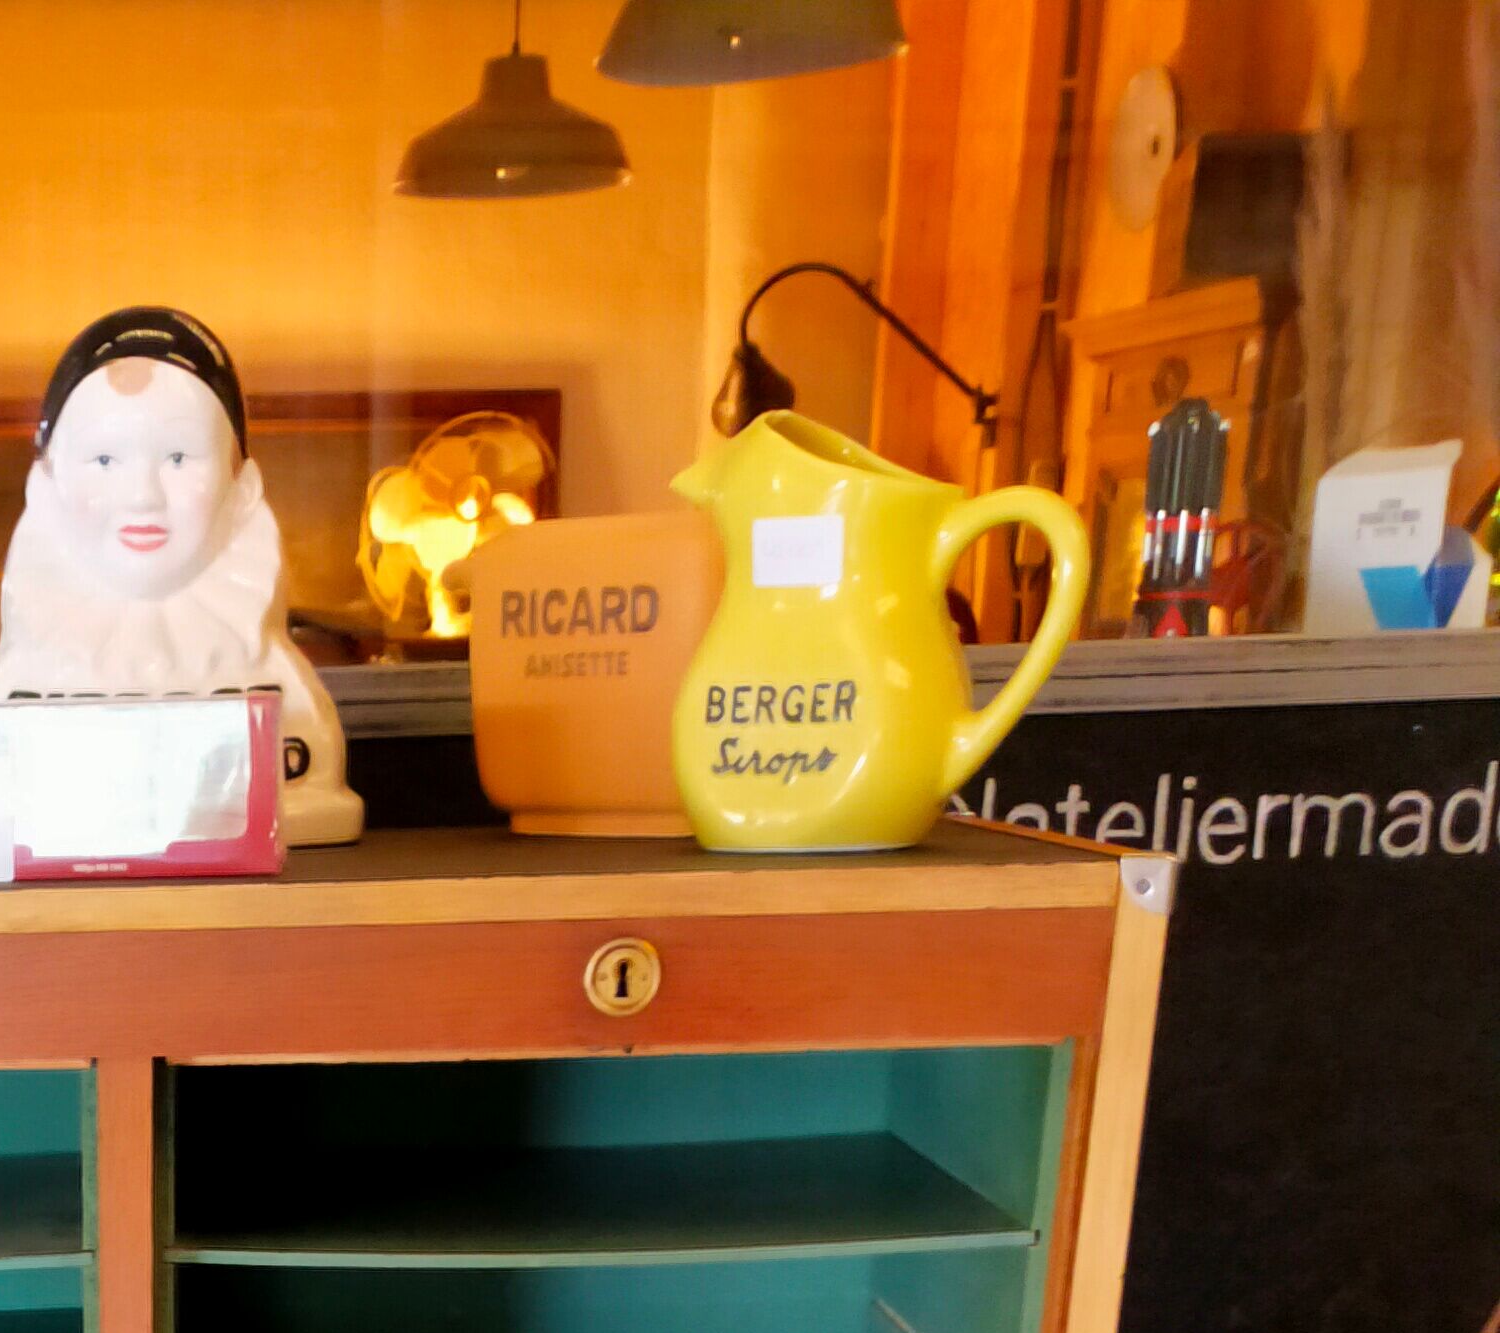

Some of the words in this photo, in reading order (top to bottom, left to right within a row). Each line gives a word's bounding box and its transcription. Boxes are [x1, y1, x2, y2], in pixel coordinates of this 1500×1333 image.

[501, 585, 659, 638] RICARD
[524, 651, 629, 678] ANISETTE
[705, 680, 857, 724] BERGER
[711, 737, 837, 784] Sirops
